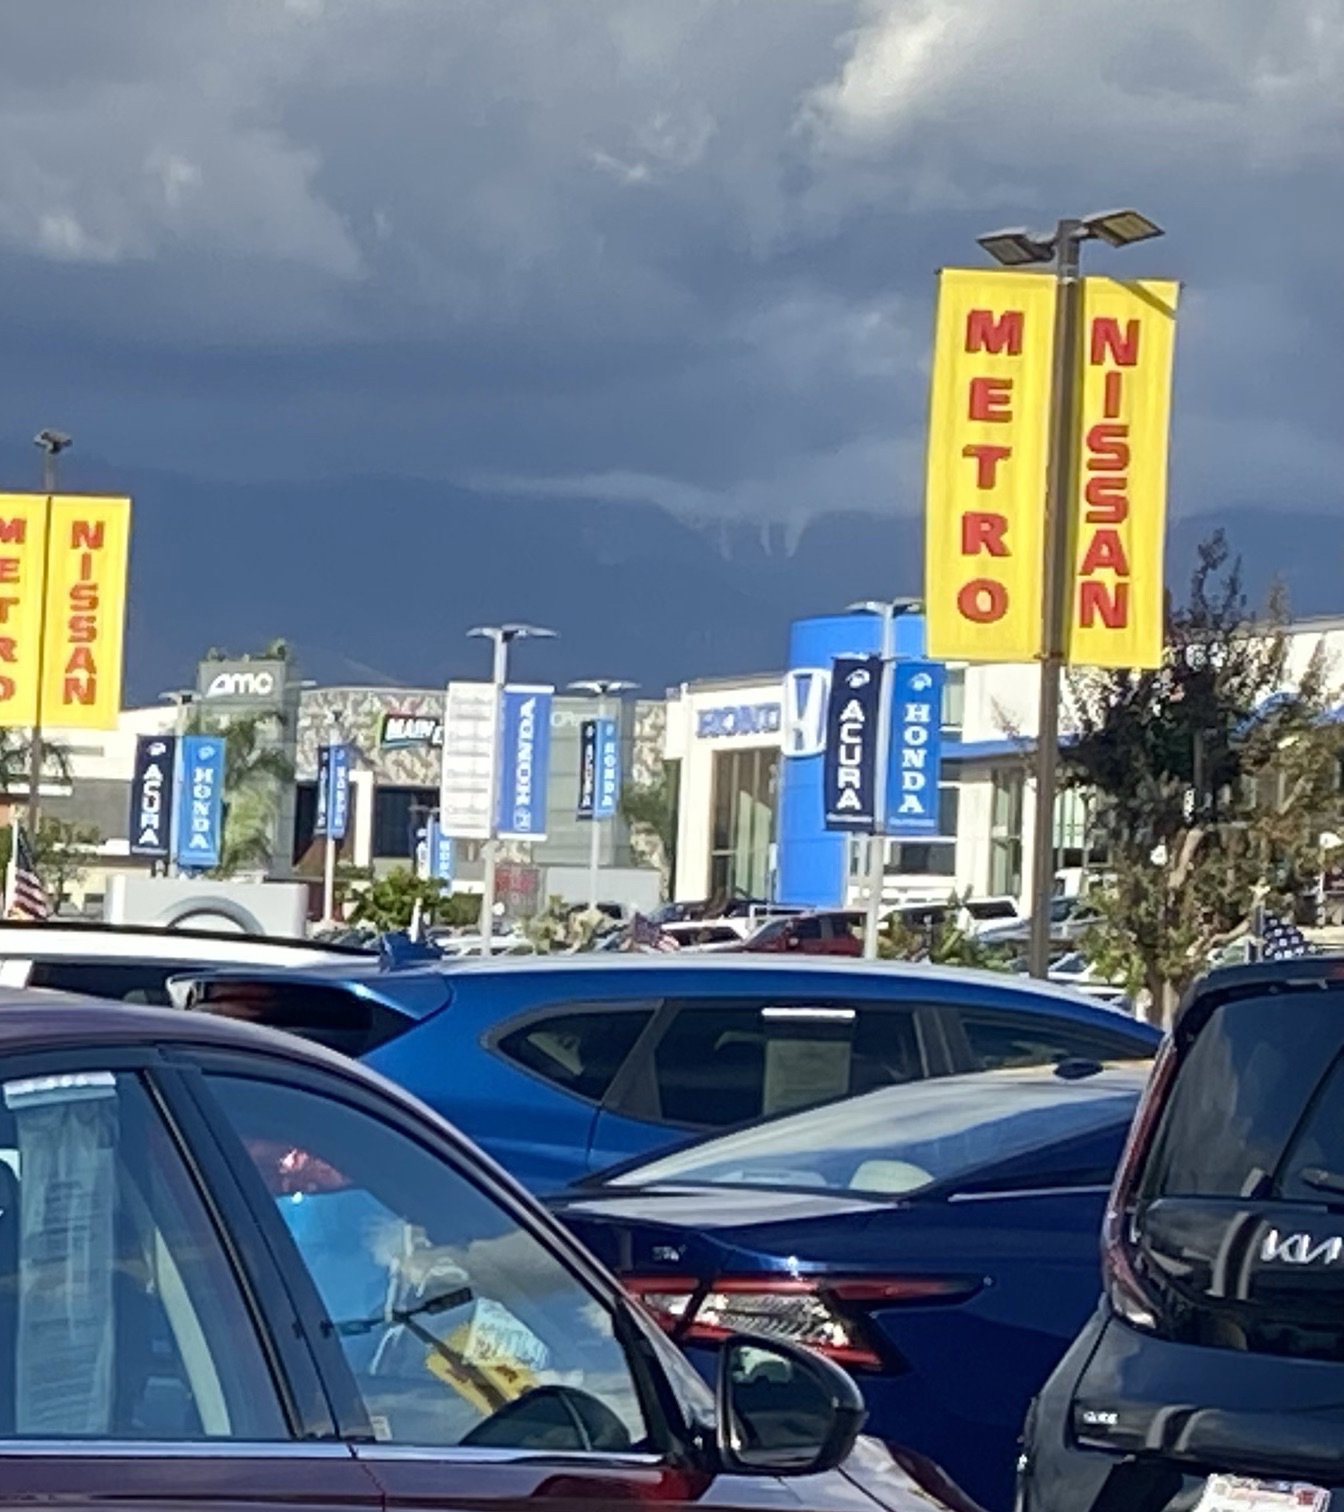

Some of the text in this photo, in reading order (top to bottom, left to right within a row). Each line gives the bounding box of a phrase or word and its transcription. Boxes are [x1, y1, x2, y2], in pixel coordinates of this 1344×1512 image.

[957, 309, 1025, 625] METRO
[1078, 317, 1140, 629] NISSAN
[62, 520, 105, 706] NISSAN
[138, 763, 164, 845] ACURA
[515, 697, 537, 806] HONDA
[837, 699, 865, 810] ACURA
[897, 703, 931, 813] HONDA
[189, 767, 214, 849] HONDA
